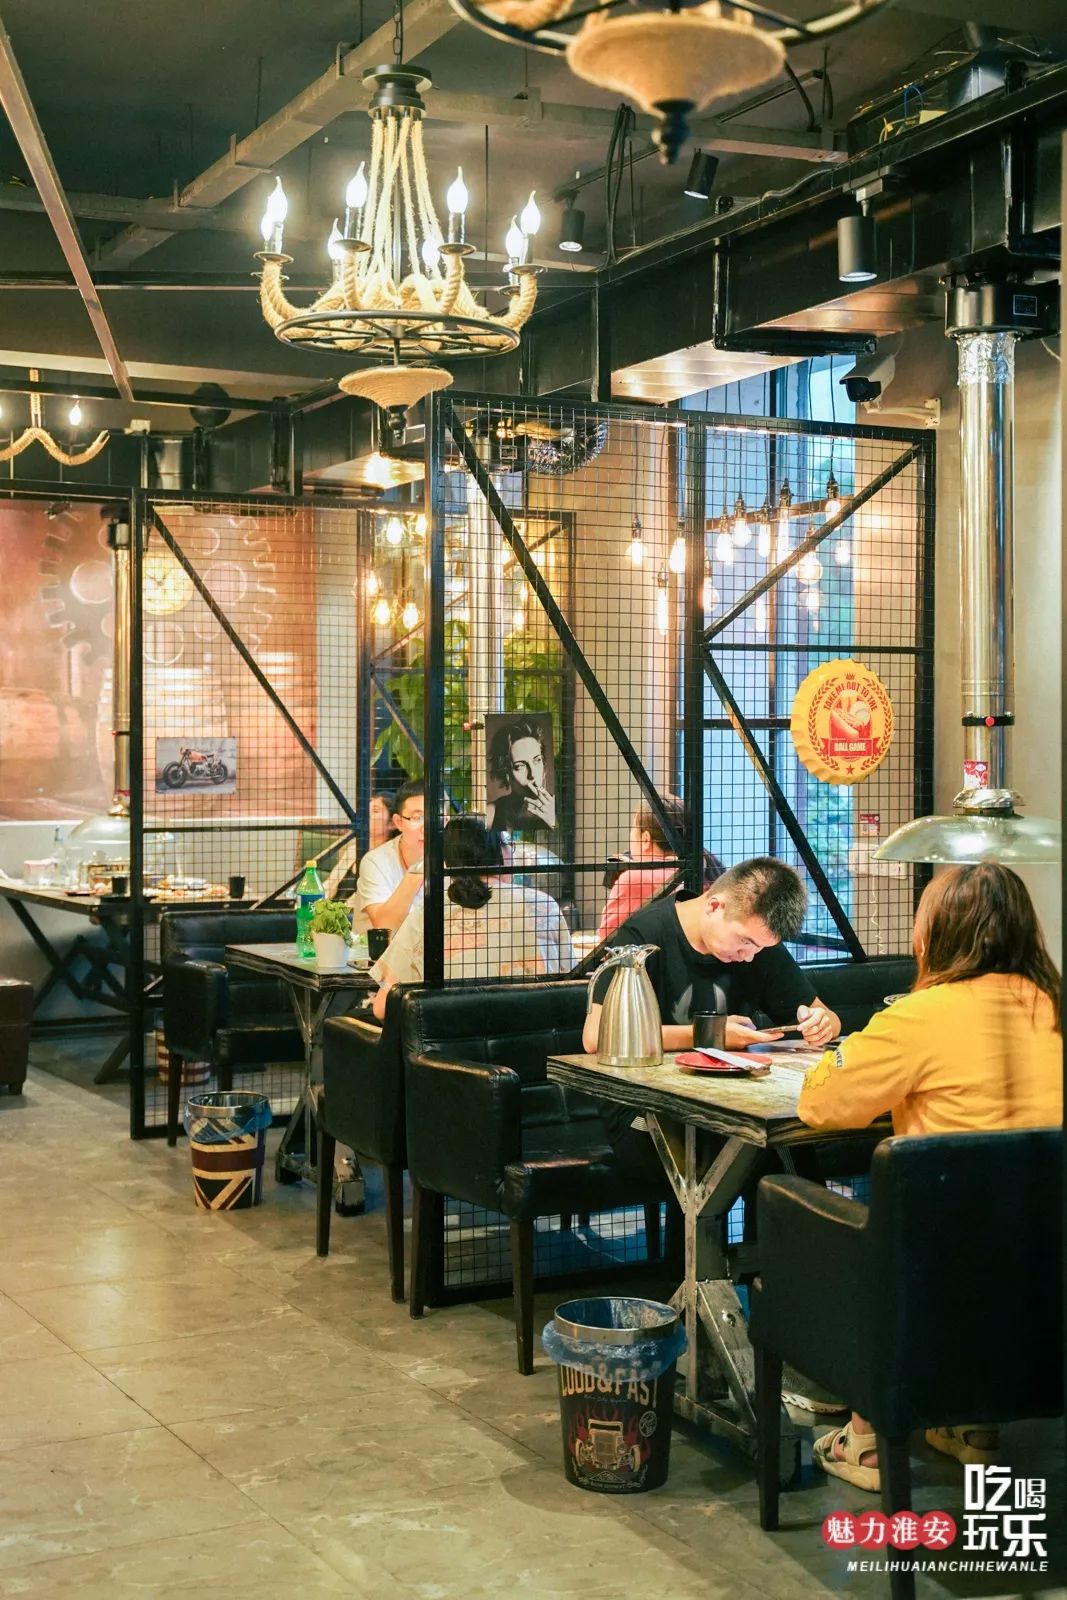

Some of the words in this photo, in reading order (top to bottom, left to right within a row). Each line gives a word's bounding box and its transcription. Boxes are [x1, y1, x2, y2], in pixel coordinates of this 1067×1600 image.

[824, 691, 837, 710] TAKE
[846, 681, 860, 691] OUT
[861, 686, 870, 698] TO
[867, 695, 878, 711] THE
[848, 742, 866, 752] GAME
